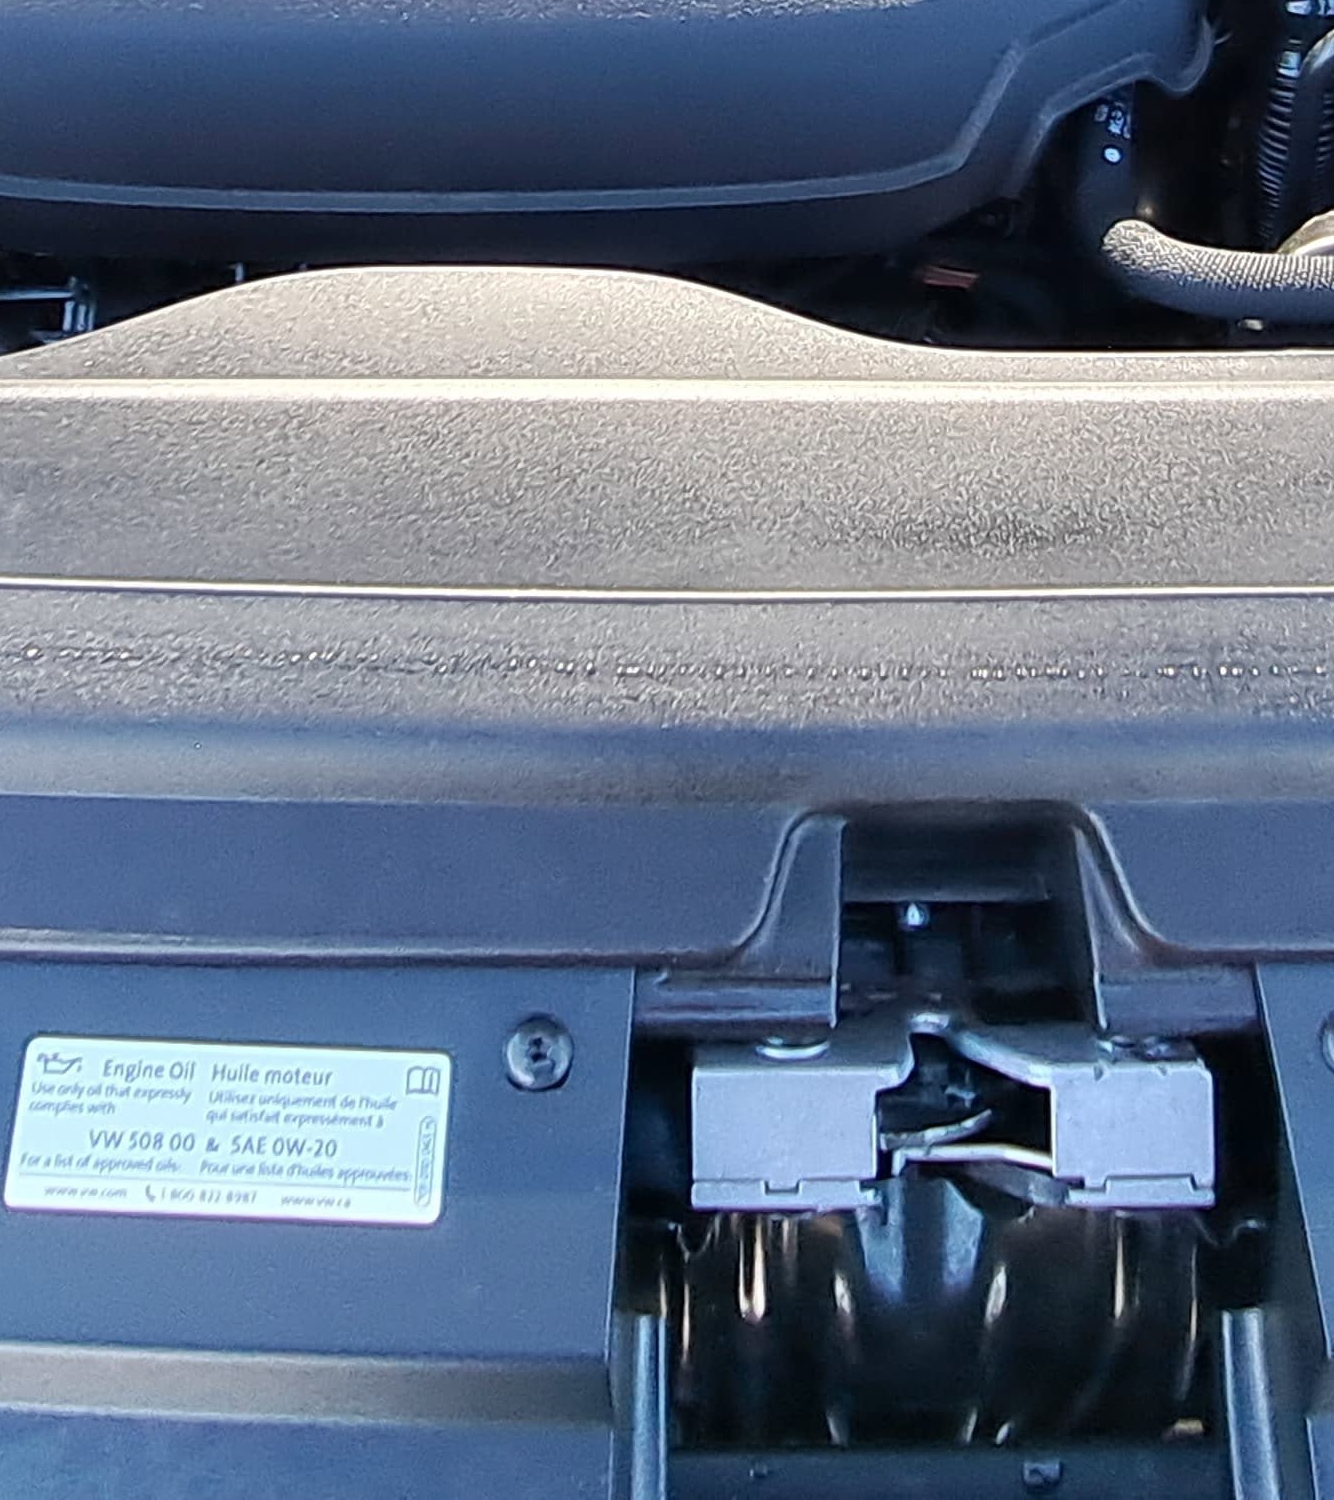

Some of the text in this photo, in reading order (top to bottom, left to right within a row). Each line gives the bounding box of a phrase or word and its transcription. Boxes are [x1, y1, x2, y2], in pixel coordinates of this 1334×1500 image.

[103, 1059, 196, 1083] Engine Oil
[211, 1063, 333, 1086] Huile moteur
[31, 1082, 192, 1104] Use only oil that expressly
[259, 1094, 336, 1110] uniquement
[340, 1095, 355, 1109] de
[28, 1100, 116, 1116] complies with
[206, 1108, 227, 1124] qui
[89, 1129, 338, 1158] VW 508 00 & SAE 0W-20
[20, 1151, 42, 1167] For
[53, 1153, 74, 1168] list
[76, 1154, 91, 1168] of
